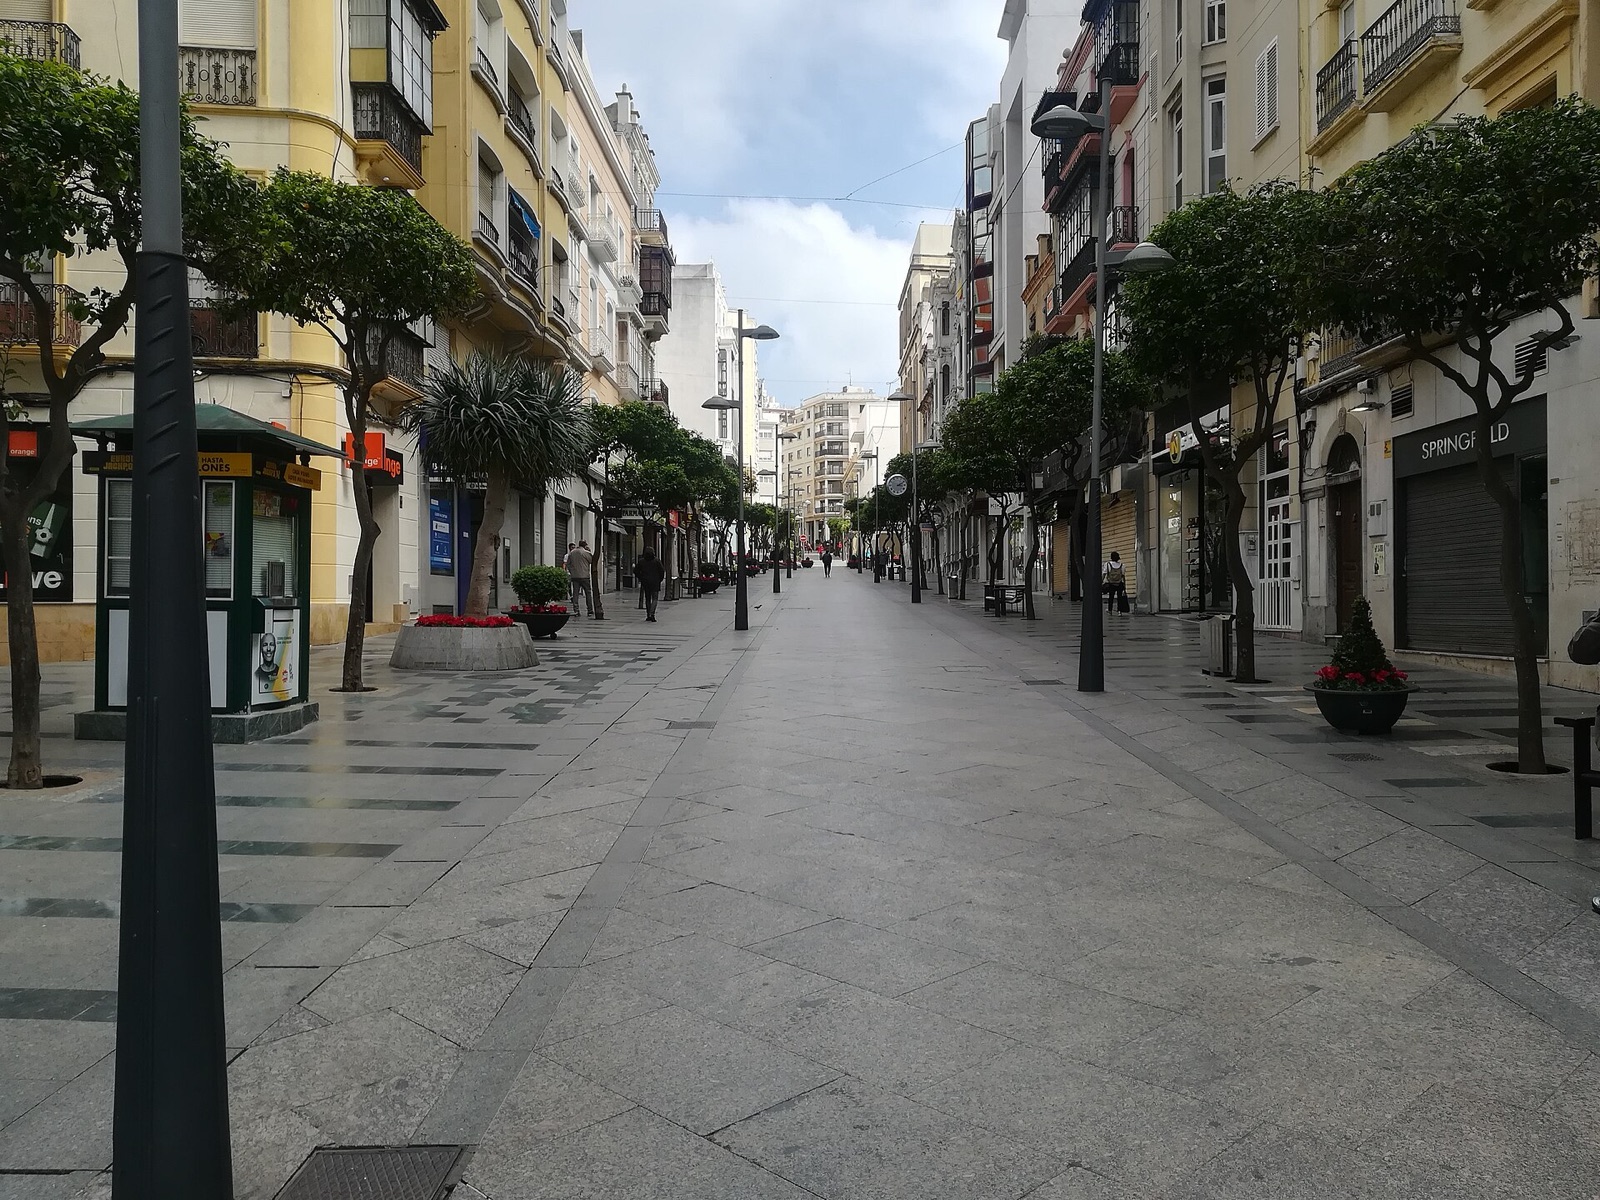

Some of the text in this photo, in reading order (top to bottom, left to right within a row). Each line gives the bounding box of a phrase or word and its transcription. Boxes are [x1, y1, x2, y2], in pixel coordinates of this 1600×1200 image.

[1421, 422, 1511, 460] SPRINGFLD
[10, 448, 35, 456] orange
[103, 462, 134, 471] JACKPO
[198, 463, 231, 472] ONES
